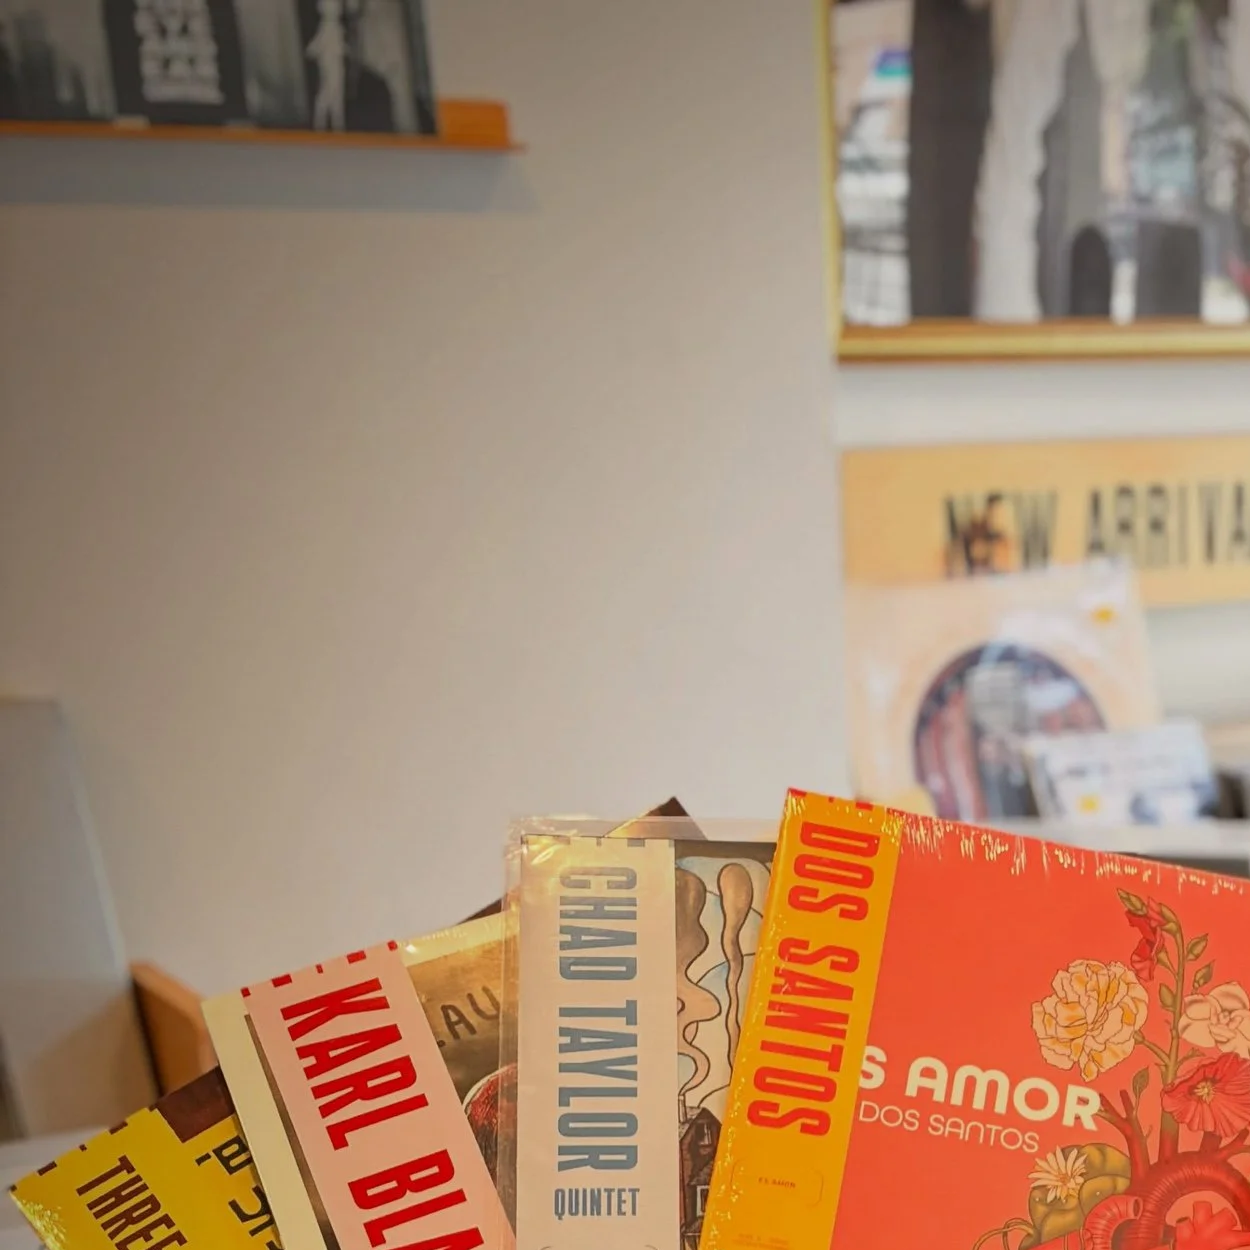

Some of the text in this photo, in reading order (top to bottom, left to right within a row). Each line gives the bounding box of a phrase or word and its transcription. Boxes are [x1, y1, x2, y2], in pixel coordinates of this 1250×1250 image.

[941, 490, 1058, 578] NEW
[788, 821, 880, 921] DOS
[280, 977, 429, 1151] KARL
[557, 866, 638, 1172] CHAD TAYLOR
[747, 936, 860, 1137] SANTOS
[858, 1101, 1039, 1153] DOS SANTOS
[904, 1056, 1101, 1131] AMOR
[554, 1187, 640, 1220] QUINTET
